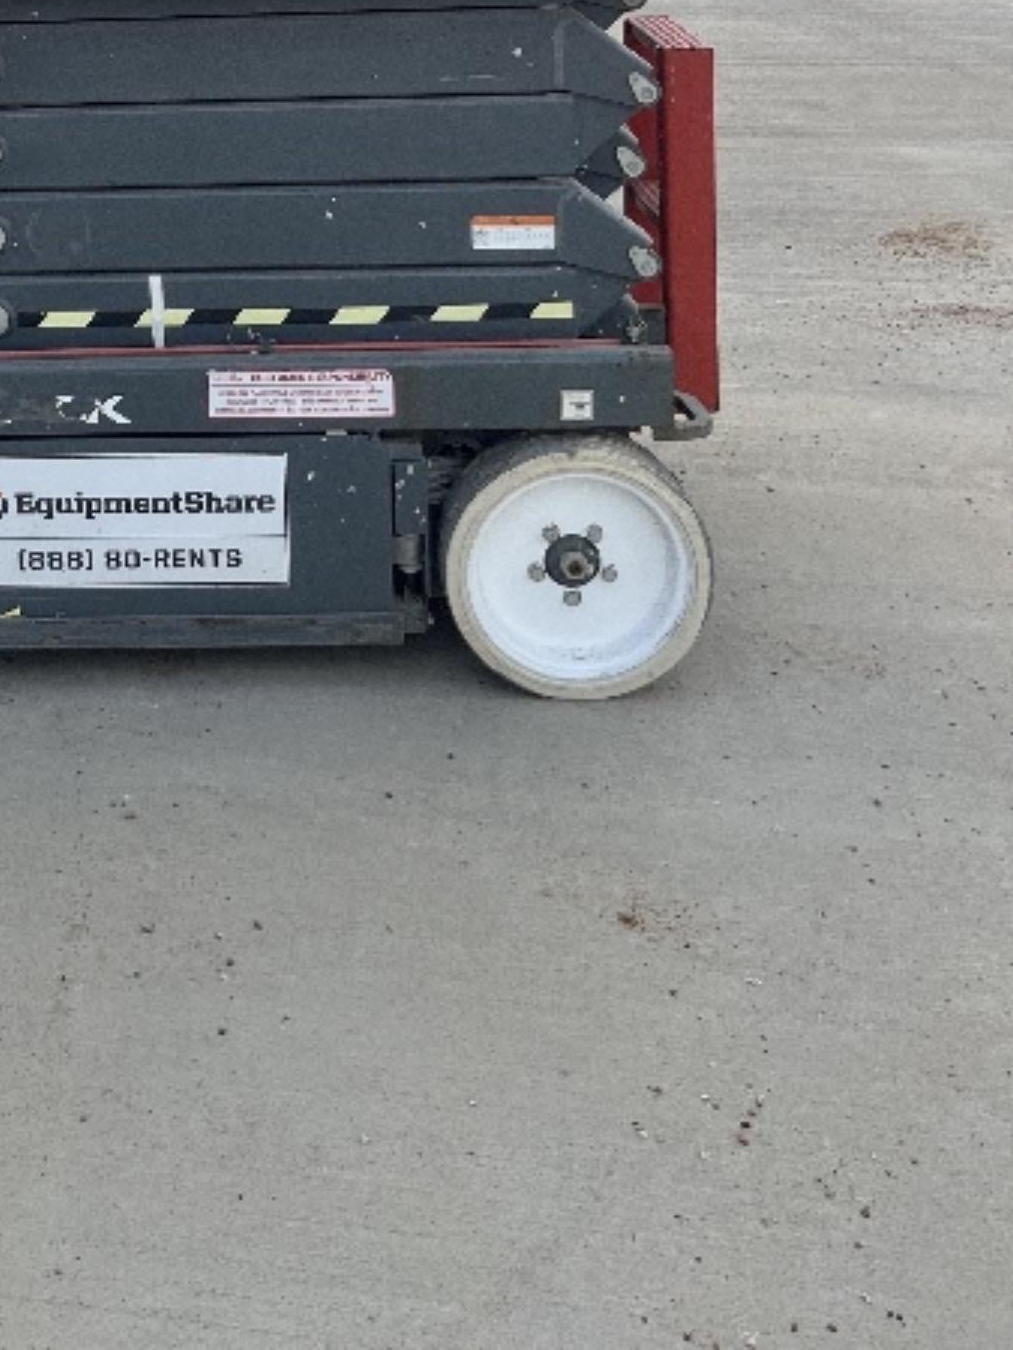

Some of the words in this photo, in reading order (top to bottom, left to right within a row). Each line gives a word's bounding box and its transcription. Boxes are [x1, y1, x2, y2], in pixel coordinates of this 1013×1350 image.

[14, 491, 276, 520] EquipmentShare
[18, 548, 94, 571] (888)
[104, 548, 243, 569] 80-RENTS
